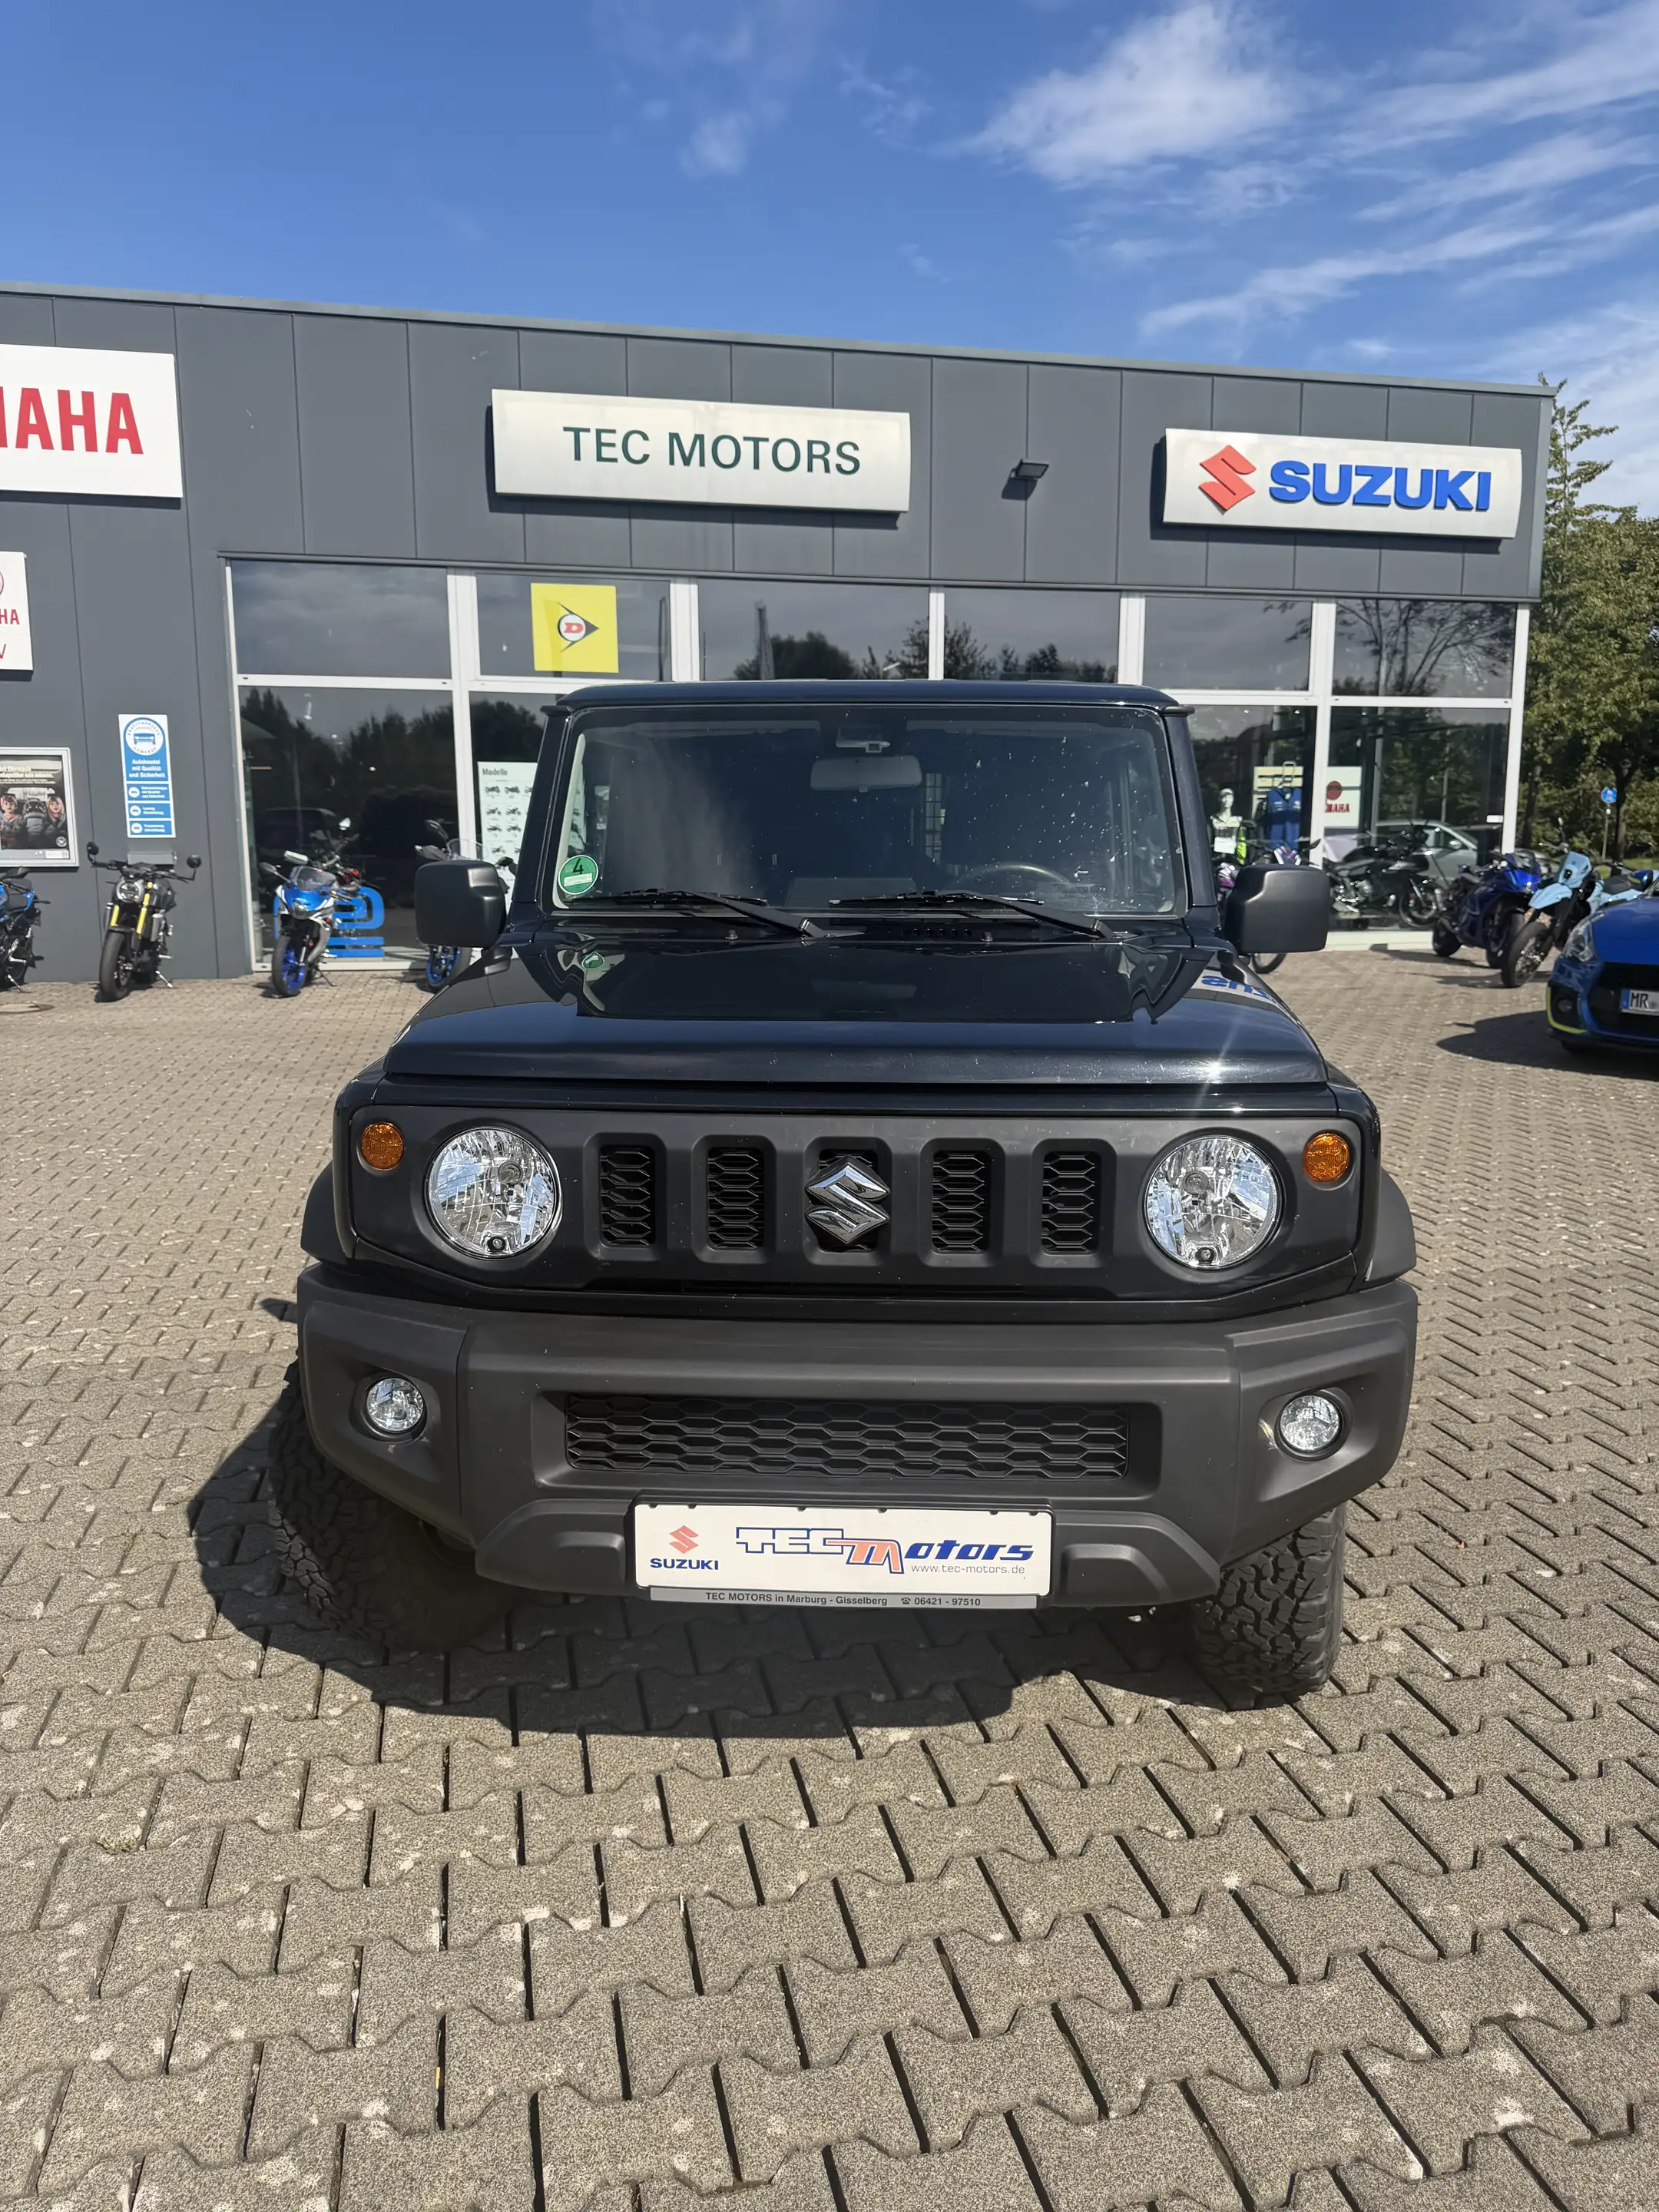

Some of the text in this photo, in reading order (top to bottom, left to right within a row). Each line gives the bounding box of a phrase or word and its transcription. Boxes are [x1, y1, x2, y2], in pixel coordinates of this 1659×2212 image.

[0, 386, 144, 455] AHA
[563, 426, 860, 475] TEC MOTORS
[1269, 460, 1492, 511] SUZUKI
[572, 858, 584, 874] 4
[1630, 992, 1649, 1008] MR
[736, 1526, 844, 1555] TEC
[650, 1558, 719, 1571] SUZUKI
[911, 1564, 1025, 1574] www.tec-motors.de
[706, 1592, 726, 1601] TEC
[729, 1593, 773, 1602] MOTORS
[775, 1594, 784, 1602] in
[786, 1595, 826, 1604] Marburg
[836, 1597, 888, 1606] Gisselberg
